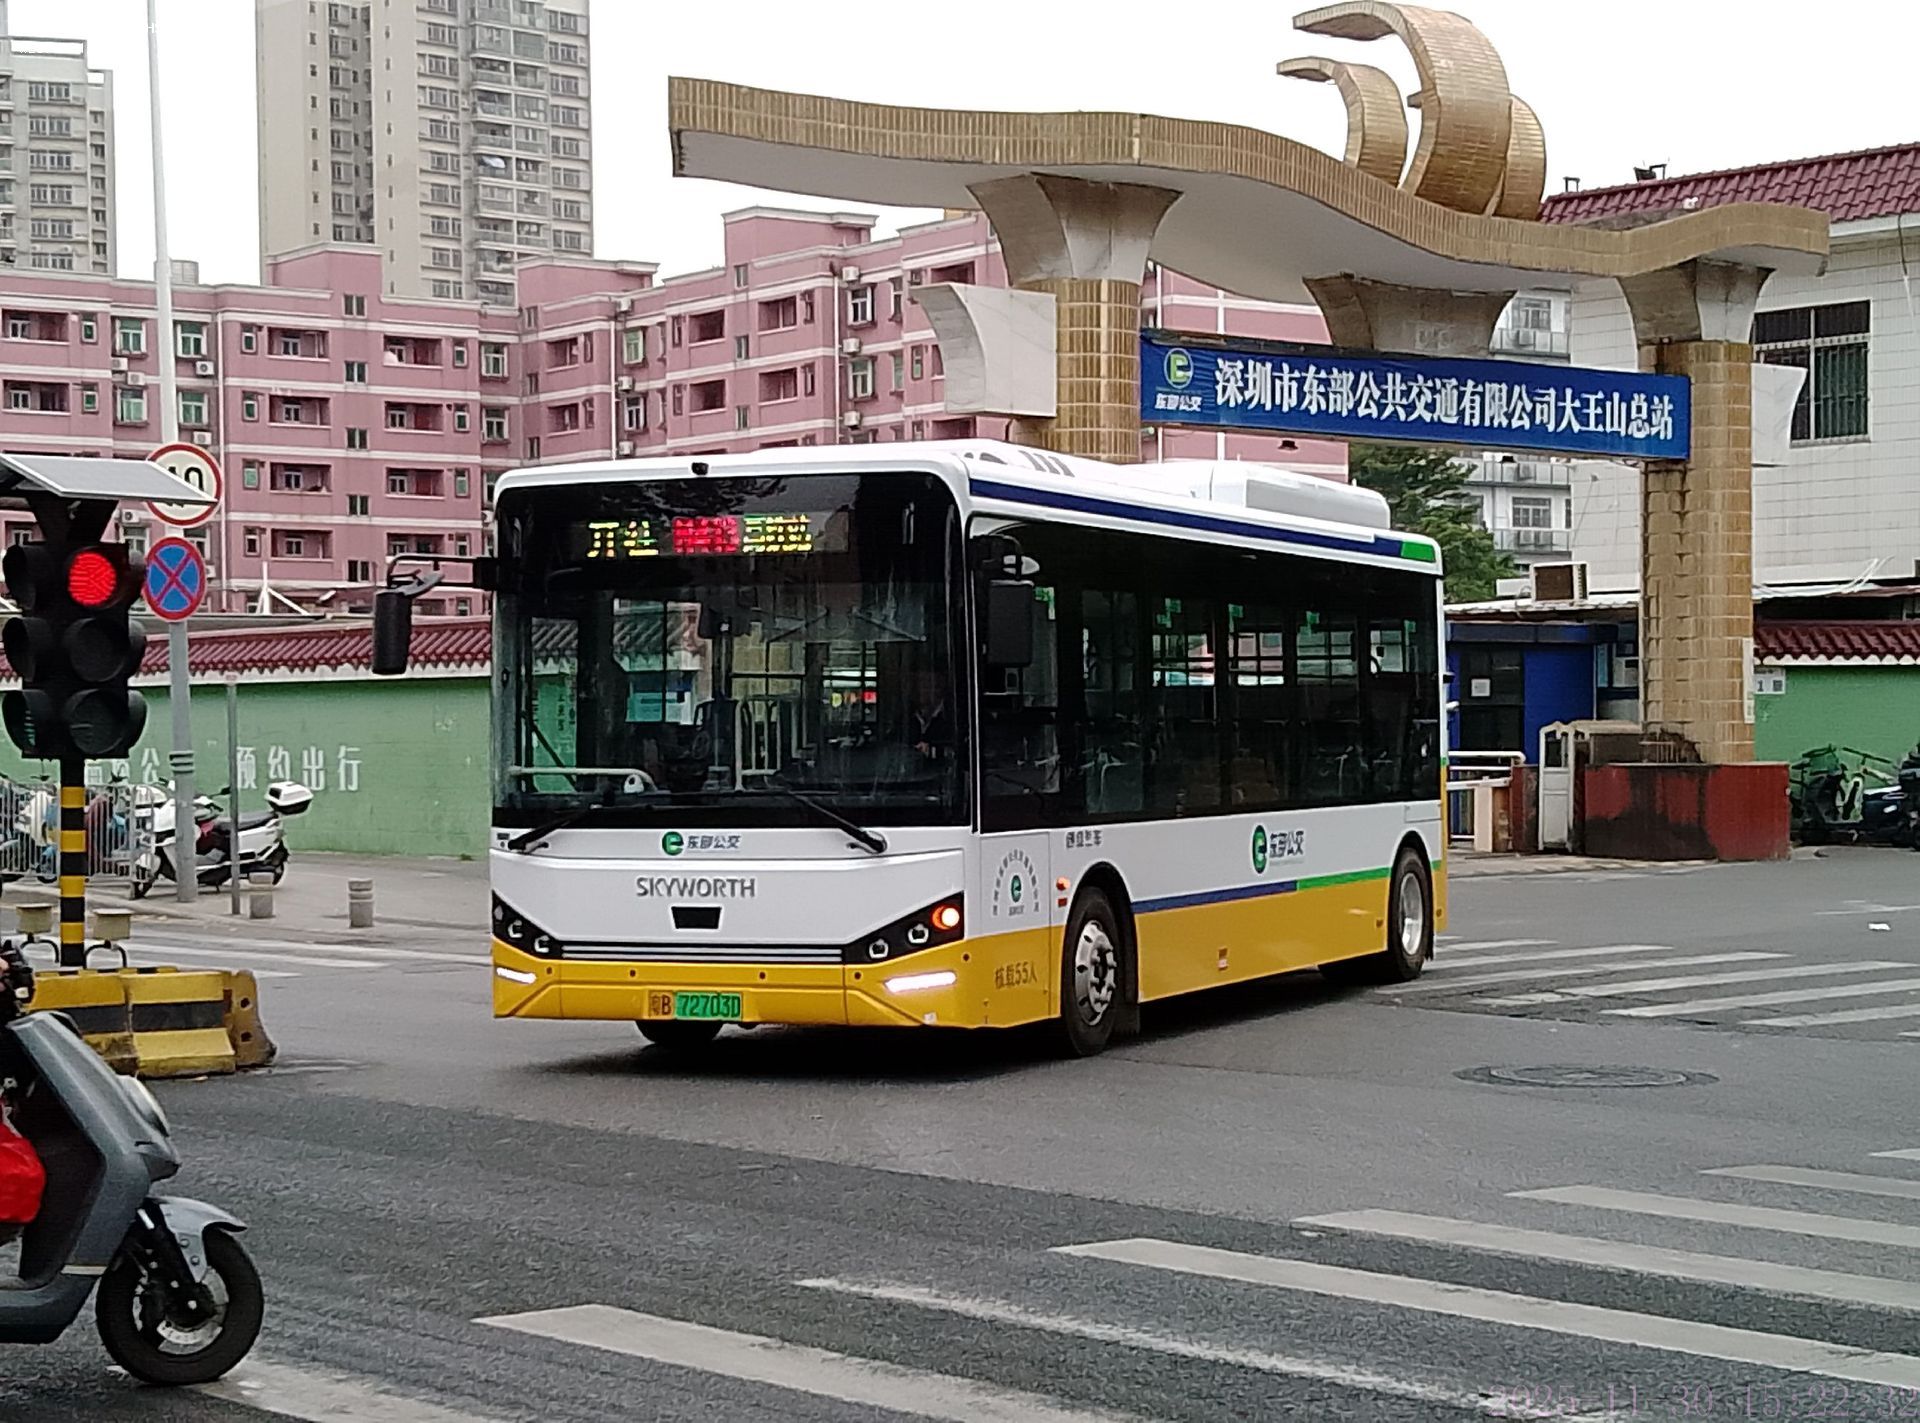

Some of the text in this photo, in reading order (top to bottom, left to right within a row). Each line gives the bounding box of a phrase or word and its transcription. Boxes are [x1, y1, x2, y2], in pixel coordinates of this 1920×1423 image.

[1214, 358, 1674, 441] 深圳市东部公共交通有限公司大王山总站
[687, 835, 741, 850] 东部公交
[635, 876, 757, 898] SKYWORTH
